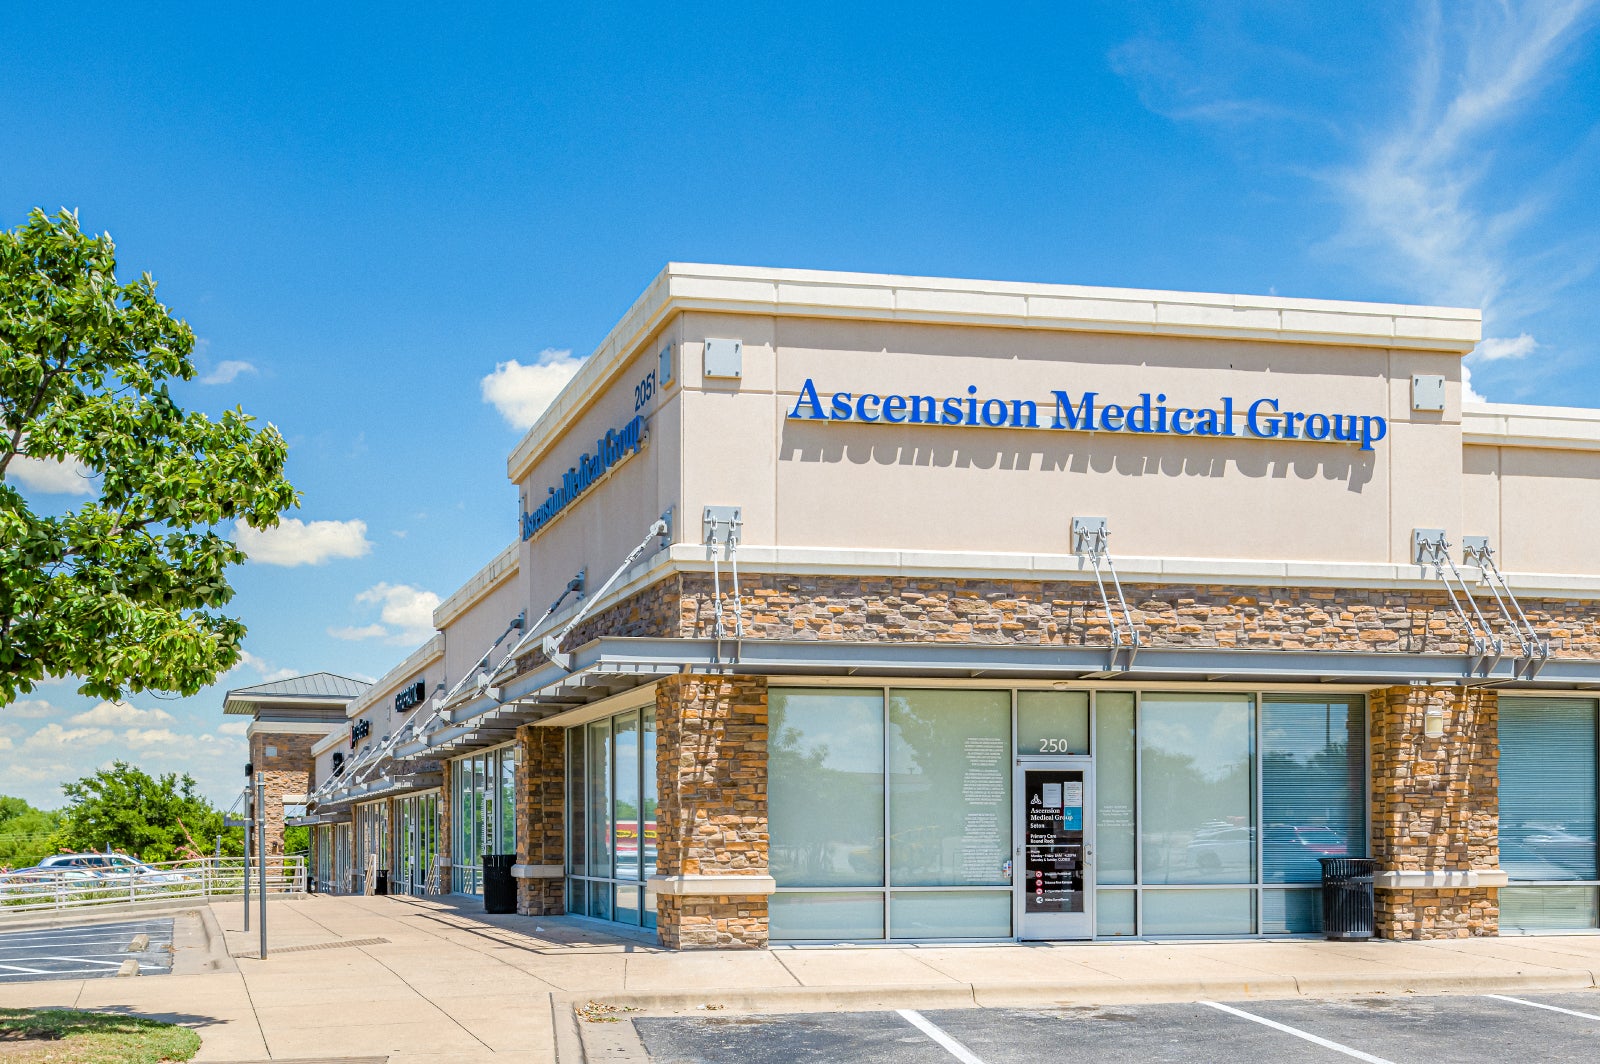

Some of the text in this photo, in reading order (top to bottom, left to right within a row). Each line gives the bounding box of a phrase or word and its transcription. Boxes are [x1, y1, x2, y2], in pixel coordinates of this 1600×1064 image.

[634, 369, 657, 412] 2051
[789, 379, 1386, 451] Ascension Medical Group
[521, 415, 645, 542] Ascension Medical Group
[1039, 738, 1068, 753] 250
